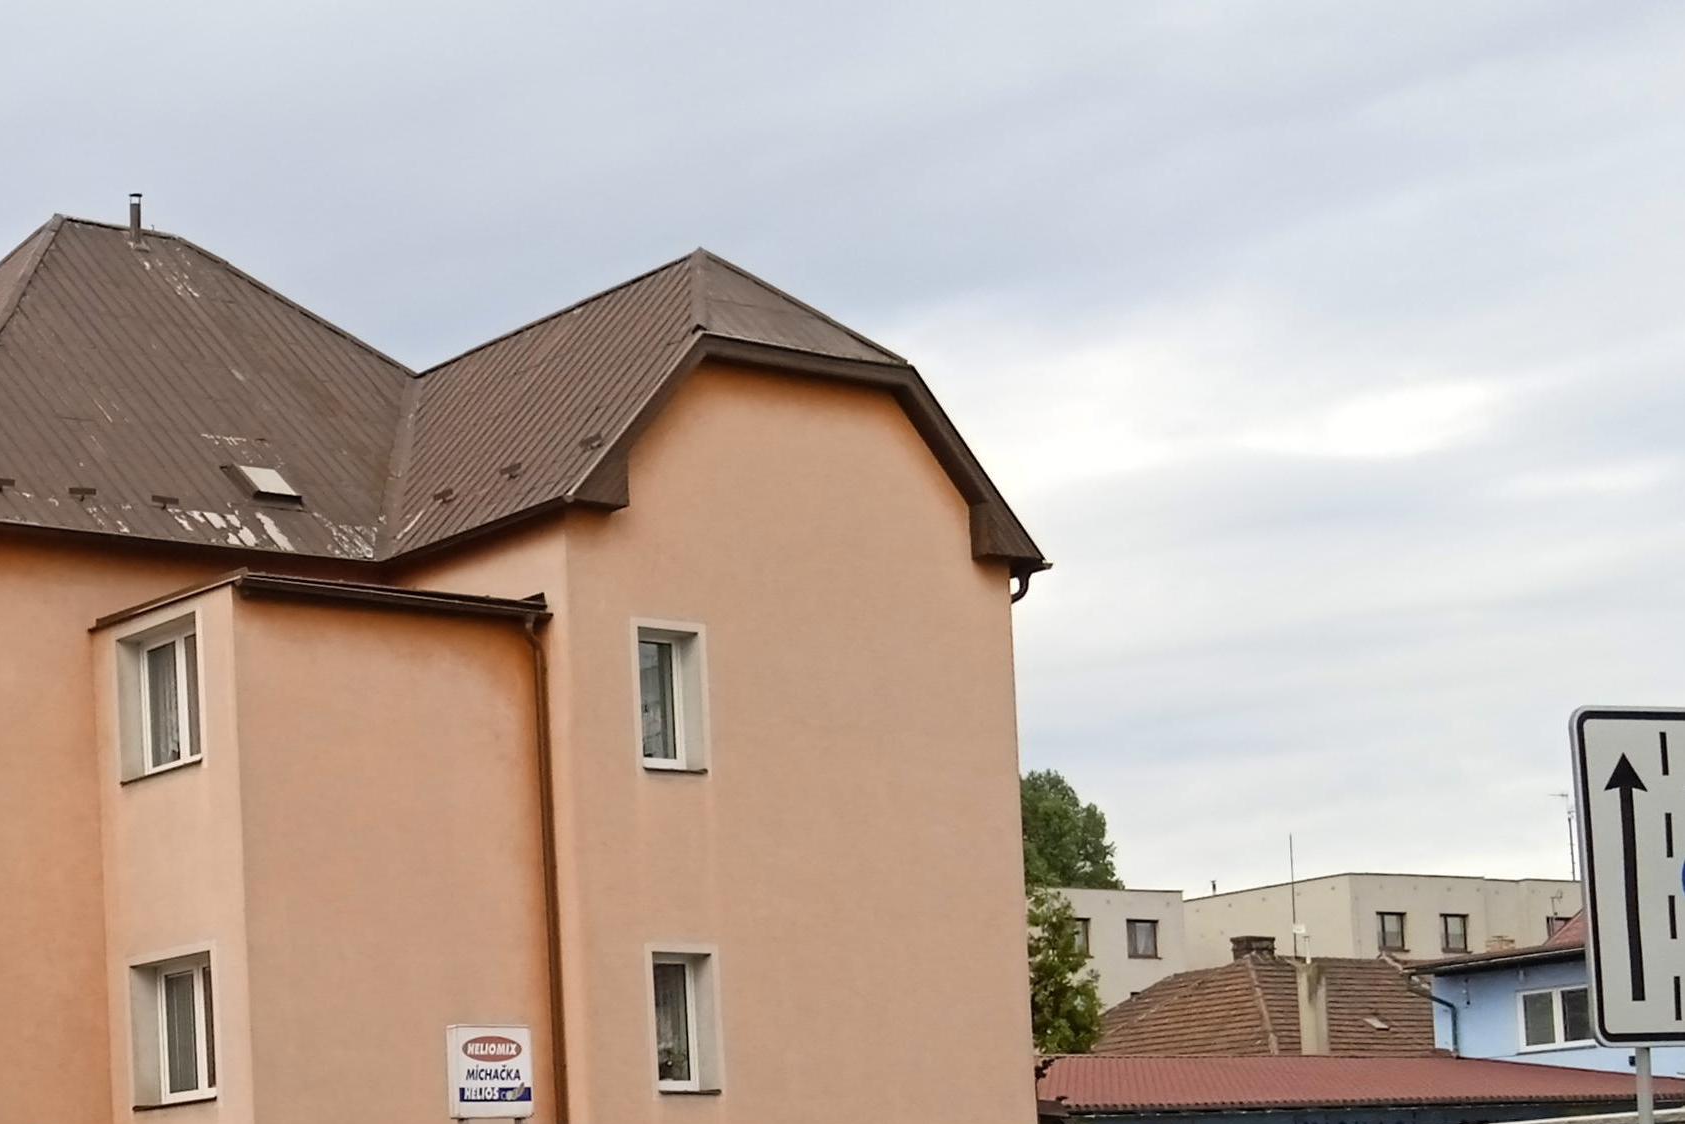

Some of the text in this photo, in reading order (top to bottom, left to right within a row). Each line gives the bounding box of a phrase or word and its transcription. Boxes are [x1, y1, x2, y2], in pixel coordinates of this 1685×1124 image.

[466, 1043, 517, 1056] HELIOMIX
[466, 1064, 521, 1080] MÍCHAČKA
[464, 1087, 499, 1100] HELIOS
